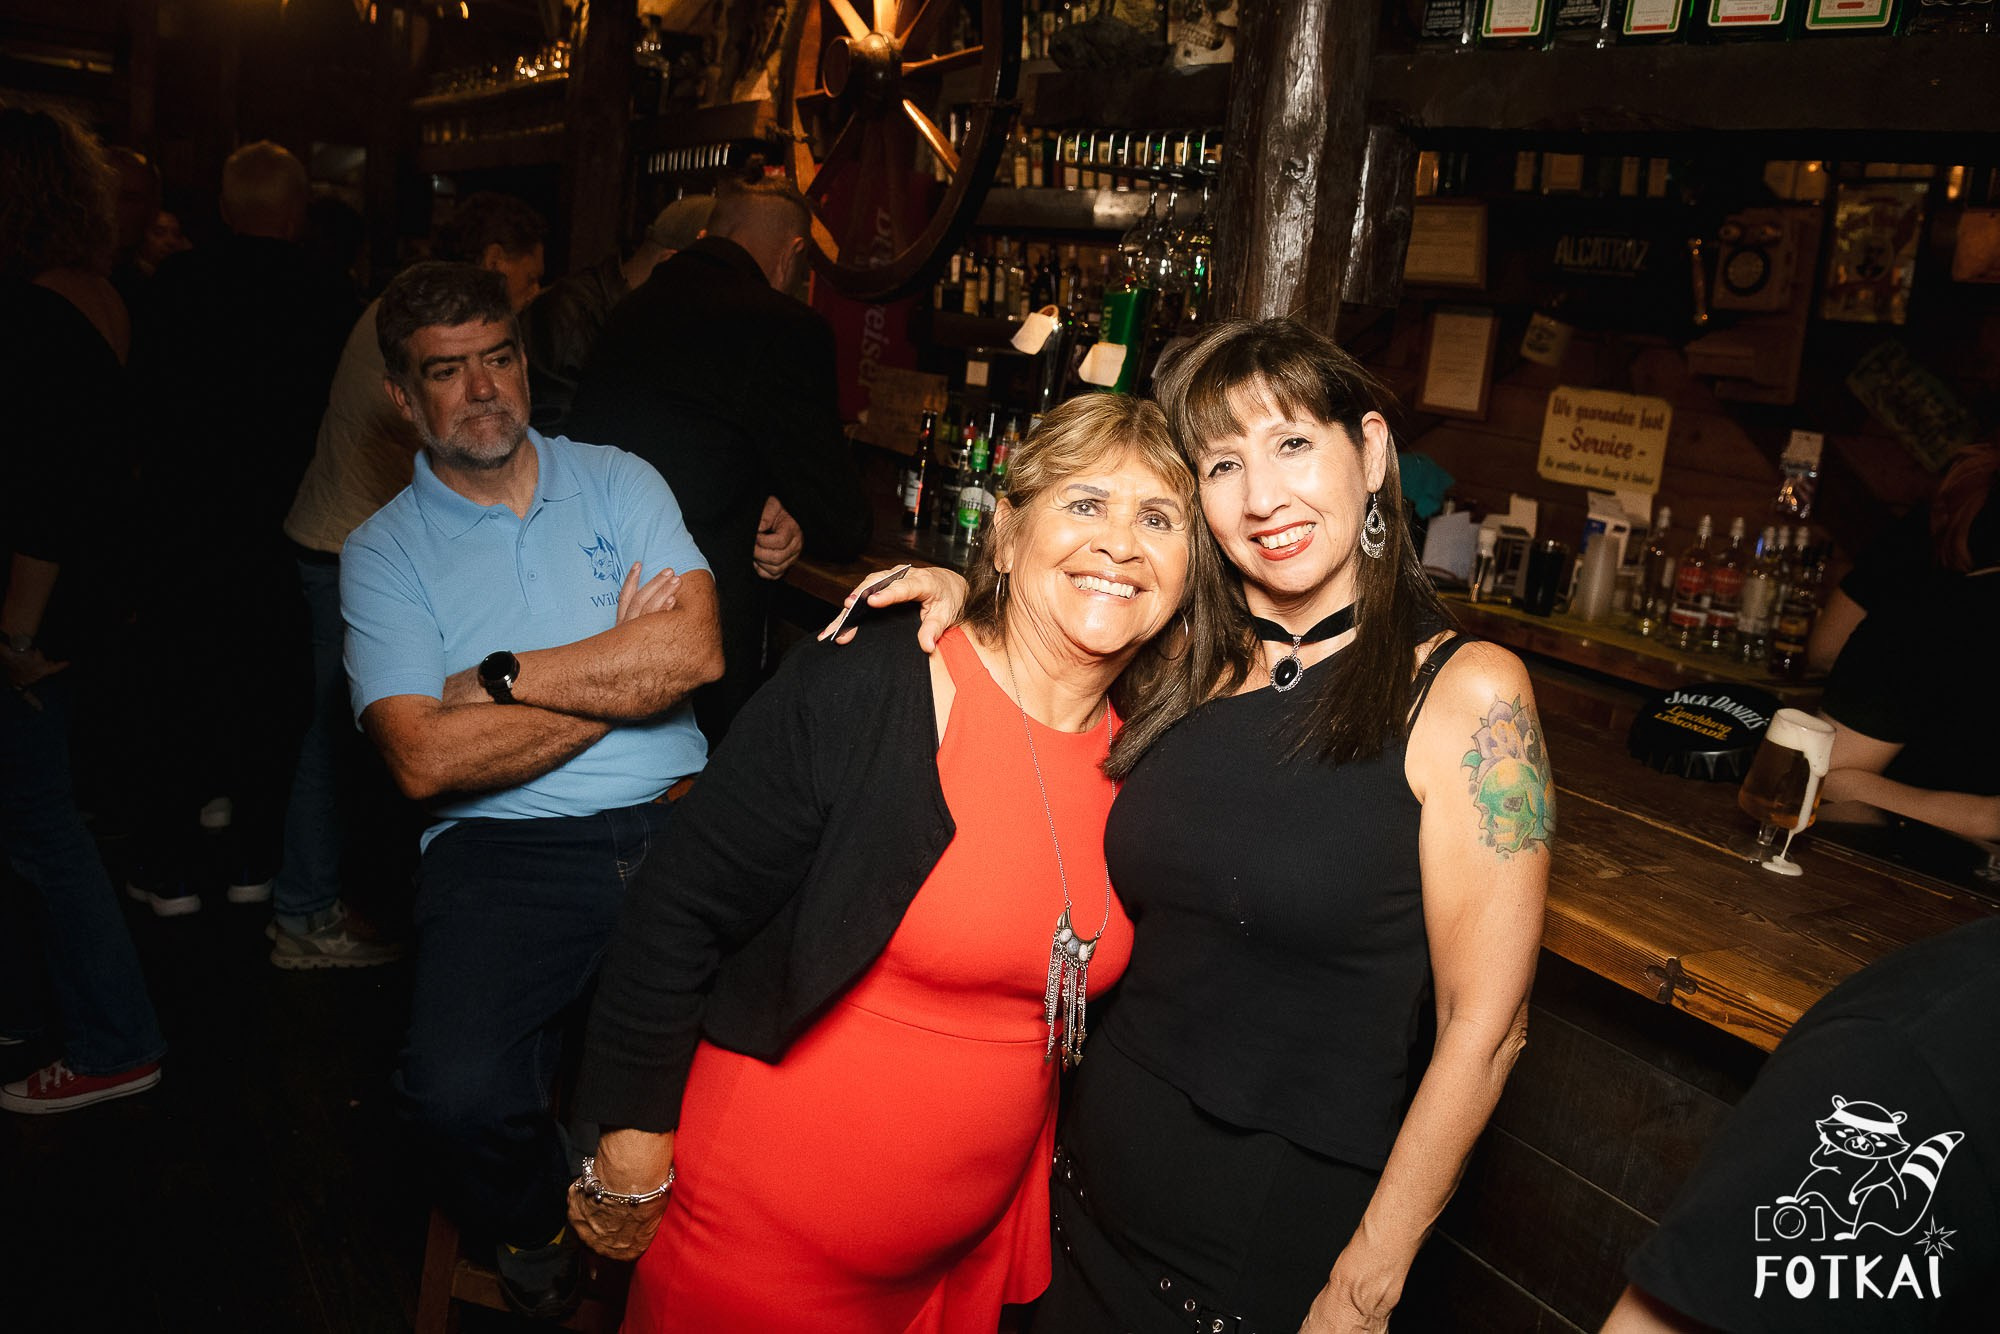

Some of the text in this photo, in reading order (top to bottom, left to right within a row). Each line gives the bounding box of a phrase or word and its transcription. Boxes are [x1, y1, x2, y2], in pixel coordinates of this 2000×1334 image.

[1553, 234, 1650, 271] ALCATRAZ
[1553, 395, 1572, 417] We
[1639, 407, 1665, 431] fast
[1570, 426, 1634, 460] Service
[1664, 691, 1713, 707] JACK
[1653, 712, 1729, 742] LEMONADE
[1666, 705, 1734, 734] Lynchburg
